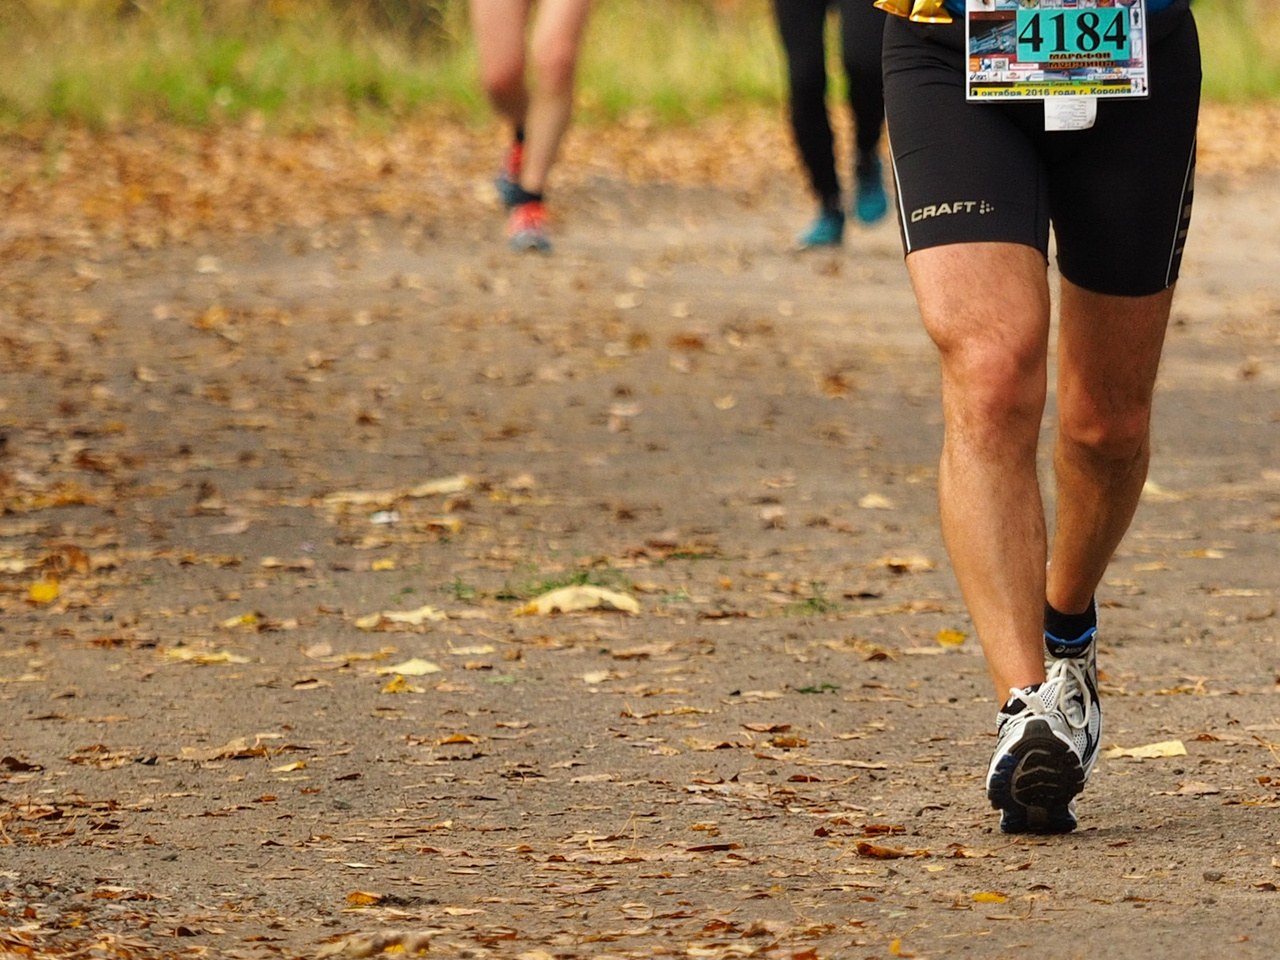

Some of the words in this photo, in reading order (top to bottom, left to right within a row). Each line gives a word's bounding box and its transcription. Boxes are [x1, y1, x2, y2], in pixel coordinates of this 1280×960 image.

[1018, 10, 1127, 53] 4184
[1049, 52, 1112, 60] МАРАФОН
[1025, 88, 1050, 96] 2016
[910, 200, 977, 224] CRAFT
